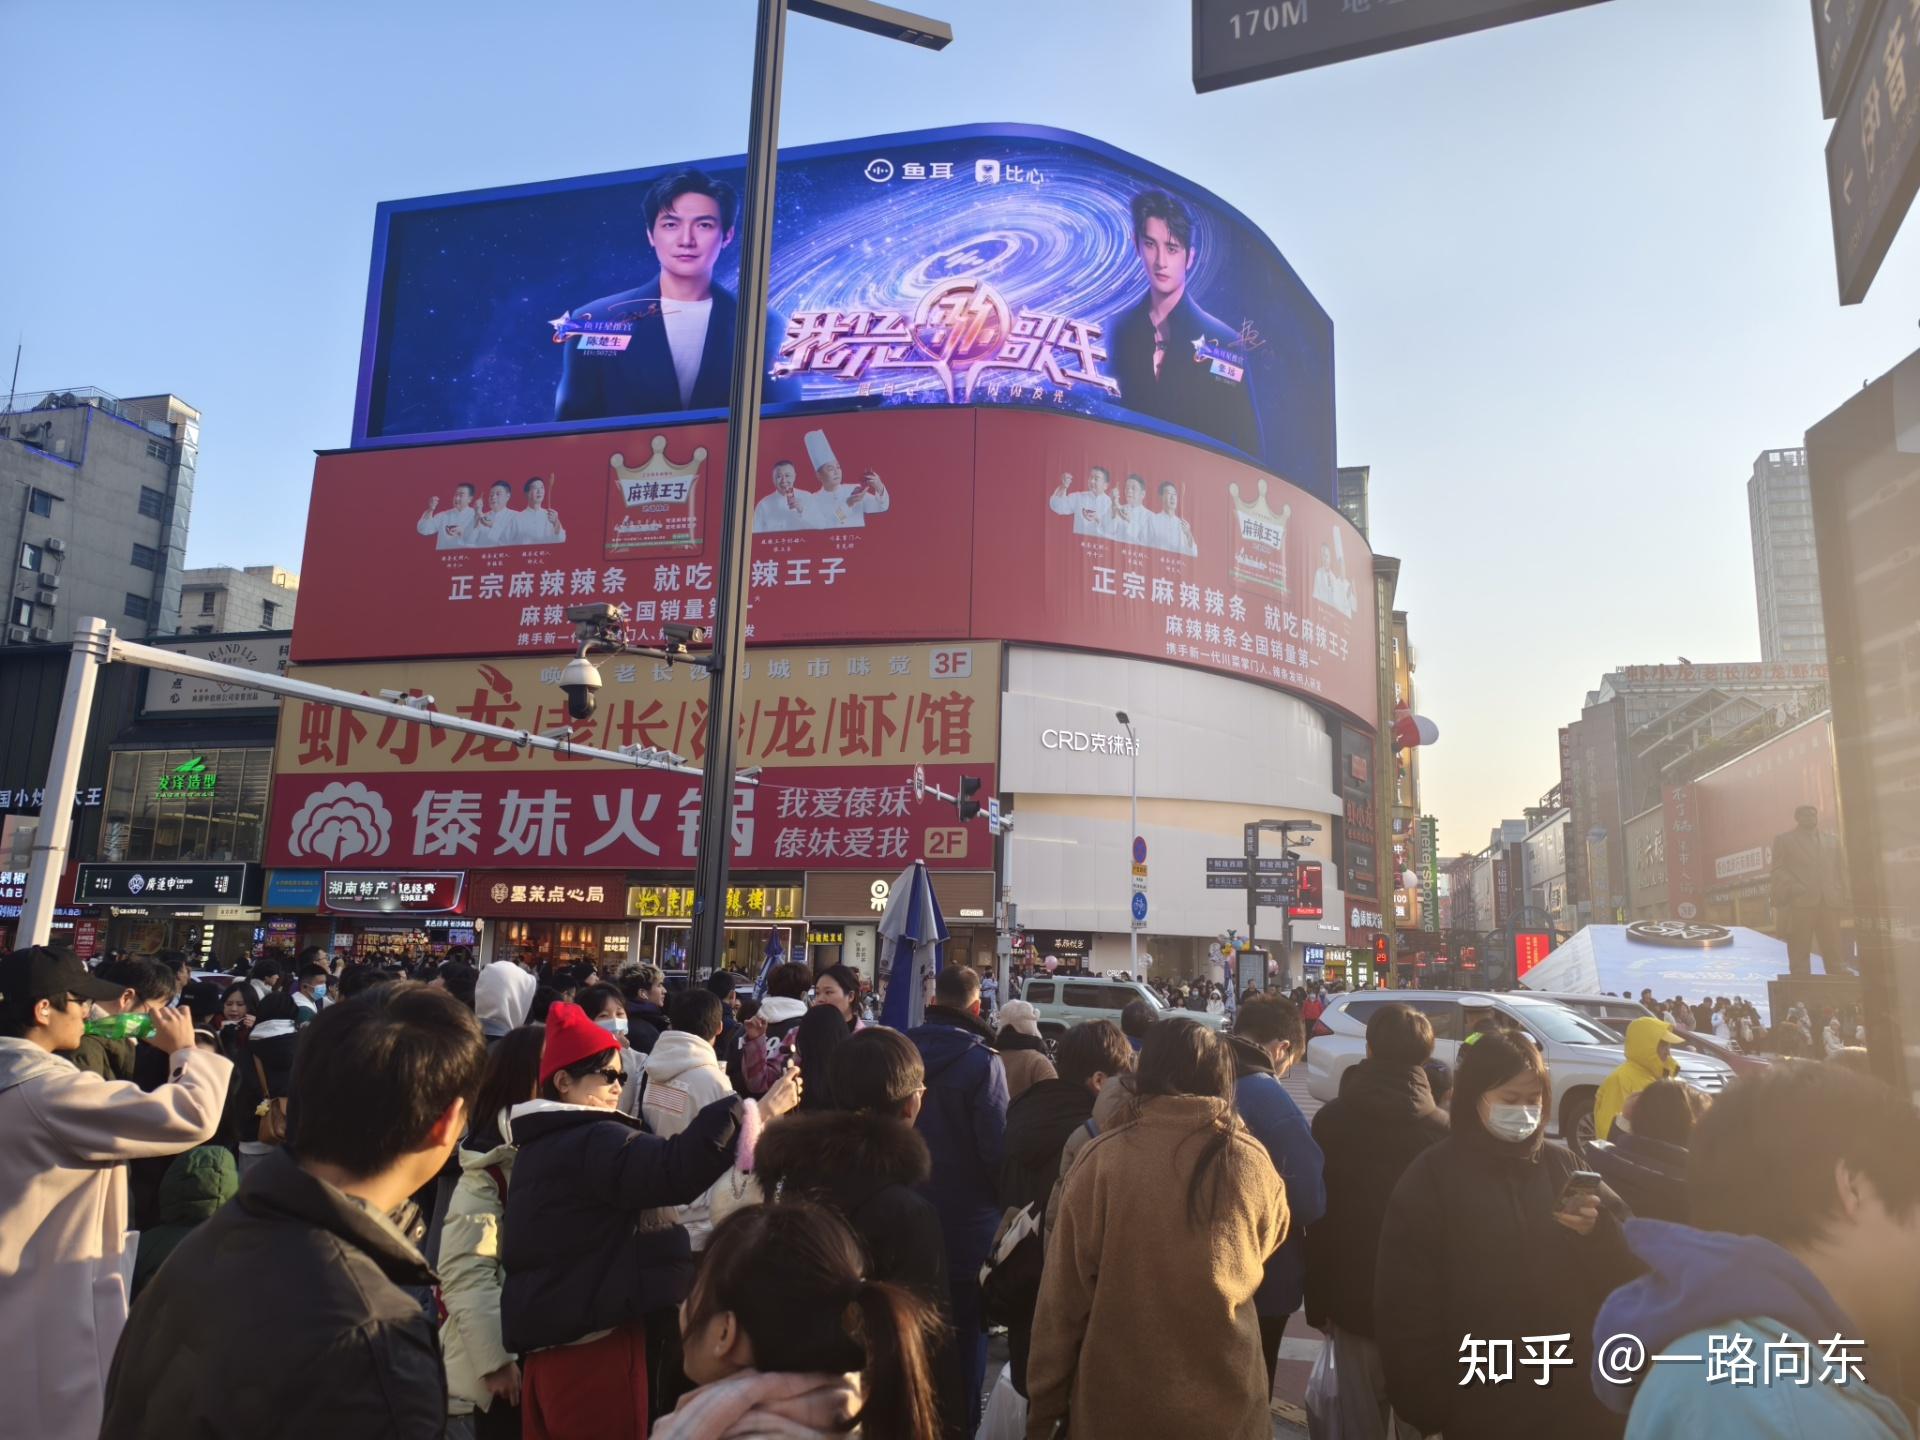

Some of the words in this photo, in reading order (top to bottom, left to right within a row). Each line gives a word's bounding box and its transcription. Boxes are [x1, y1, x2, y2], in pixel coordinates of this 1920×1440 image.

[1229, 4, 1309, 39] 170M
[902, 162, 954, 180] 鱼耳
[1005, 164, 1044, 185] 比心
[628, 482, 687, 502] 麻辣王子
[1242, 518, 1281, 547] 麻辣王子
[448, 567, 627, 601] 正宗麻辣辣条
[653, 557, 847, 592] 就吃辣王子
[1092, 566, 1247, 623] 正宗麻辣辣条
[1264, 604, 1349, 662] 就吃麻辣王子
[540, 655, 911, 686] 唤老长沙城市味觉
[934, 652, 968, 674] 3F
[778, 786, 912, 820] 我爱傣妹
[412, 787, 753, 857] 傣妹火锅
[774, 826, 910, 859] 傣妹爱我
[929, 830, 964, 855] 2F
[328, 881, 389, 896] 湖南特产
[510, 885, 605, 903] 墨茉点心局
[1376, 953, 1387, 962] 29
